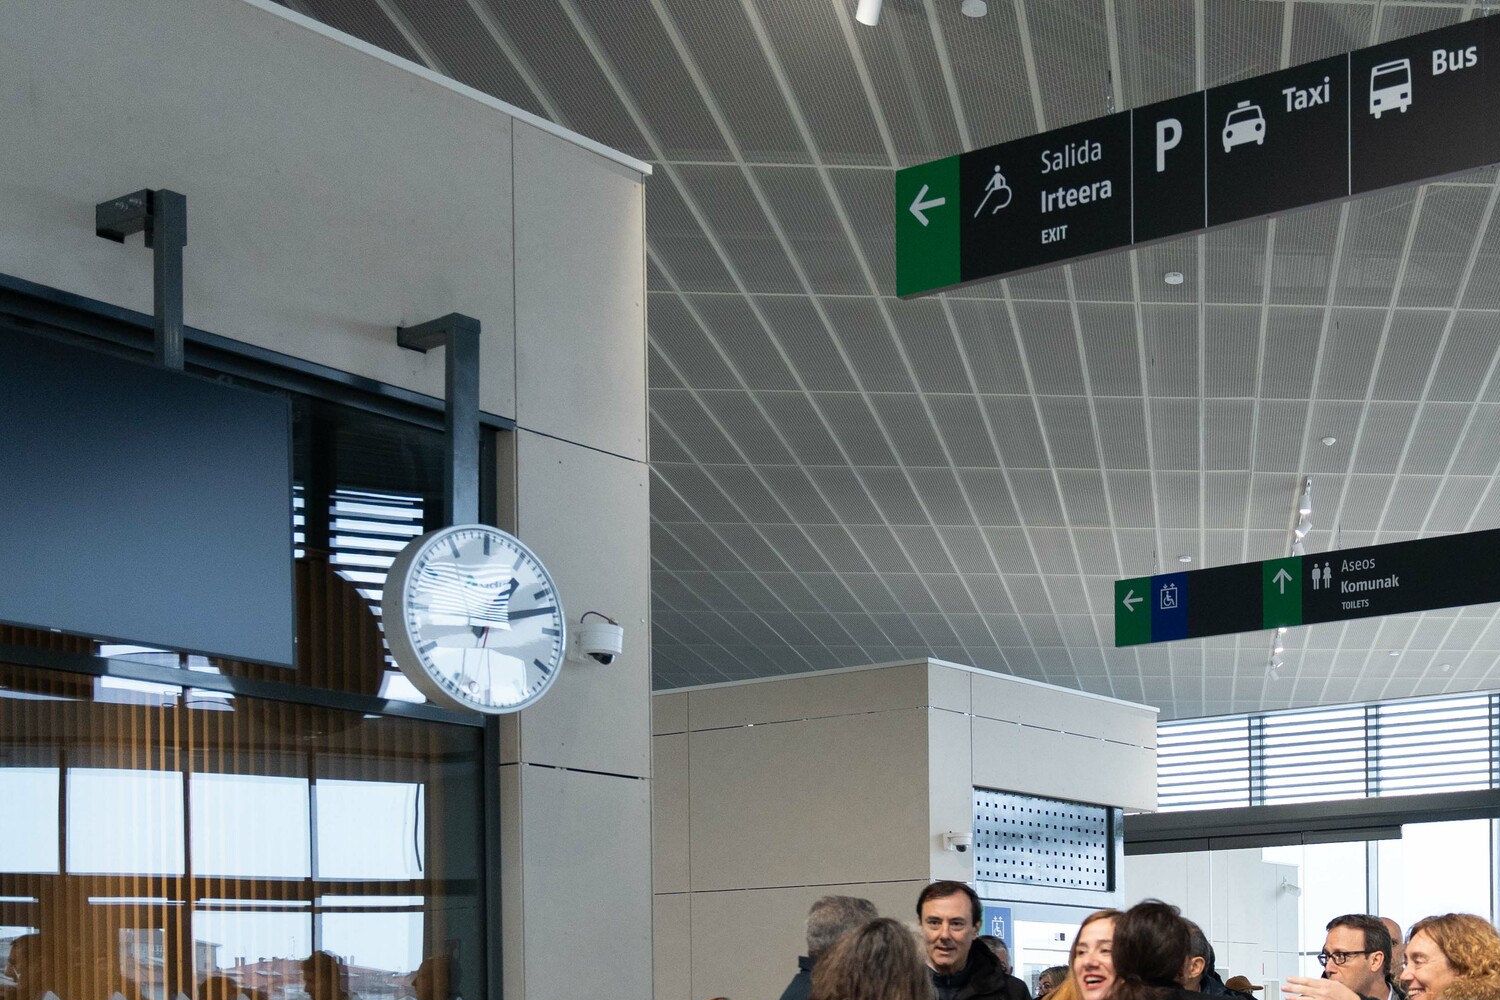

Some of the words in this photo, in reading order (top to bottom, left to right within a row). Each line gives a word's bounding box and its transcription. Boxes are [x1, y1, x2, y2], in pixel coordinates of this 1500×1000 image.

[1432, 45, 1479, 76] Bus
[1282, 75, 1331, 113] Taxi
[1041, 139, 1102, 174] Salida
[1156, 118, 1184, 173] P
[1041, 178, 1112, 214] Irteera
[1041, 225, 1068, 245] EXIT
[1341, 558, 1377, 573] Aseos
[1341, 573, 1401, 595] Komunak
[1341, 599, 1370, 611] TOILETS
